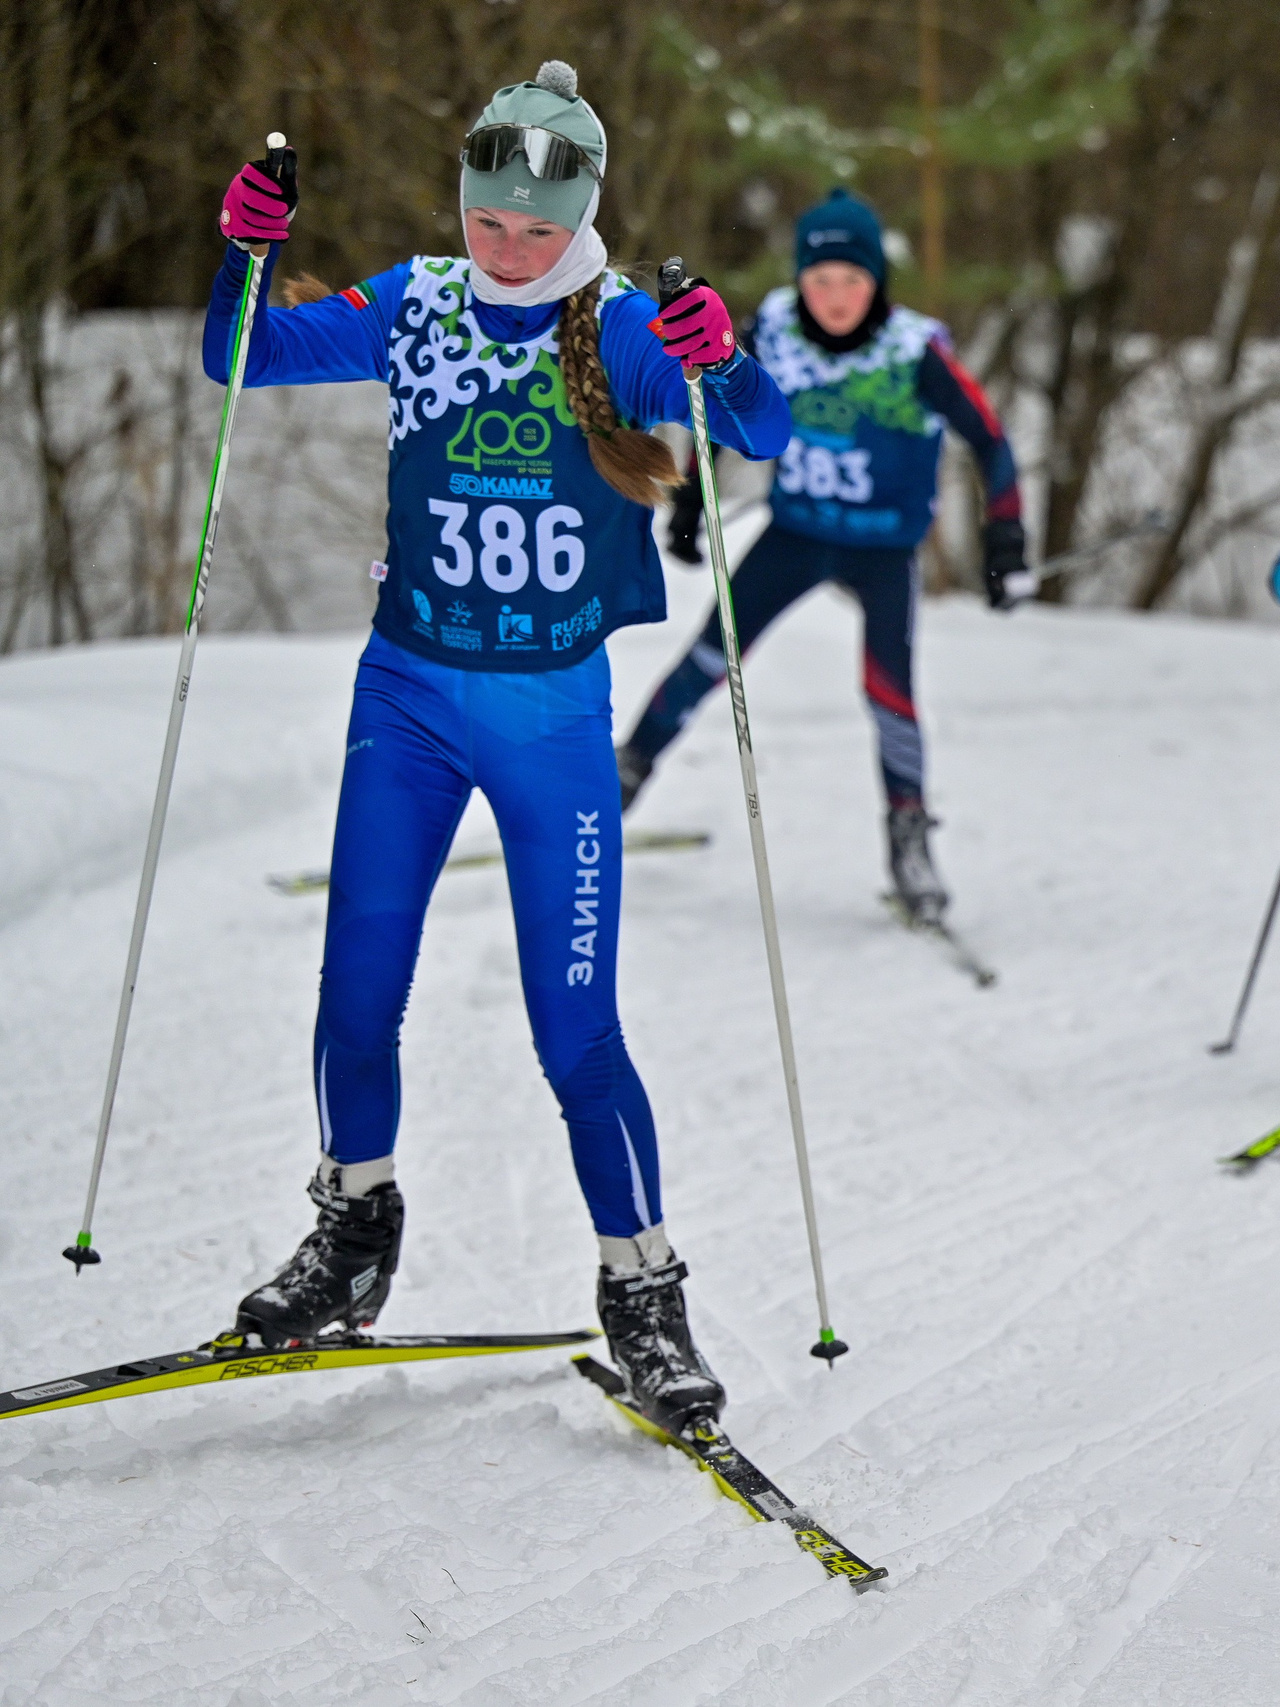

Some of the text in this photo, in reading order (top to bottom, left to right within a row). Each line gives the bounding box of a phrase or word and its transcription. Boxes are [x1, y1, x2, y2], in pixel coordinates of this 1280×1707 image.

[447, 407, 551, 471] 400
[777, 436, 874, 503] 383
[428, 498, 585, 593] 386
[747, 792, 758, 819] TBS
[567, 810, 600, 987] ЗАИНСК
[219, 1354, 319, 1380] FISCHER
